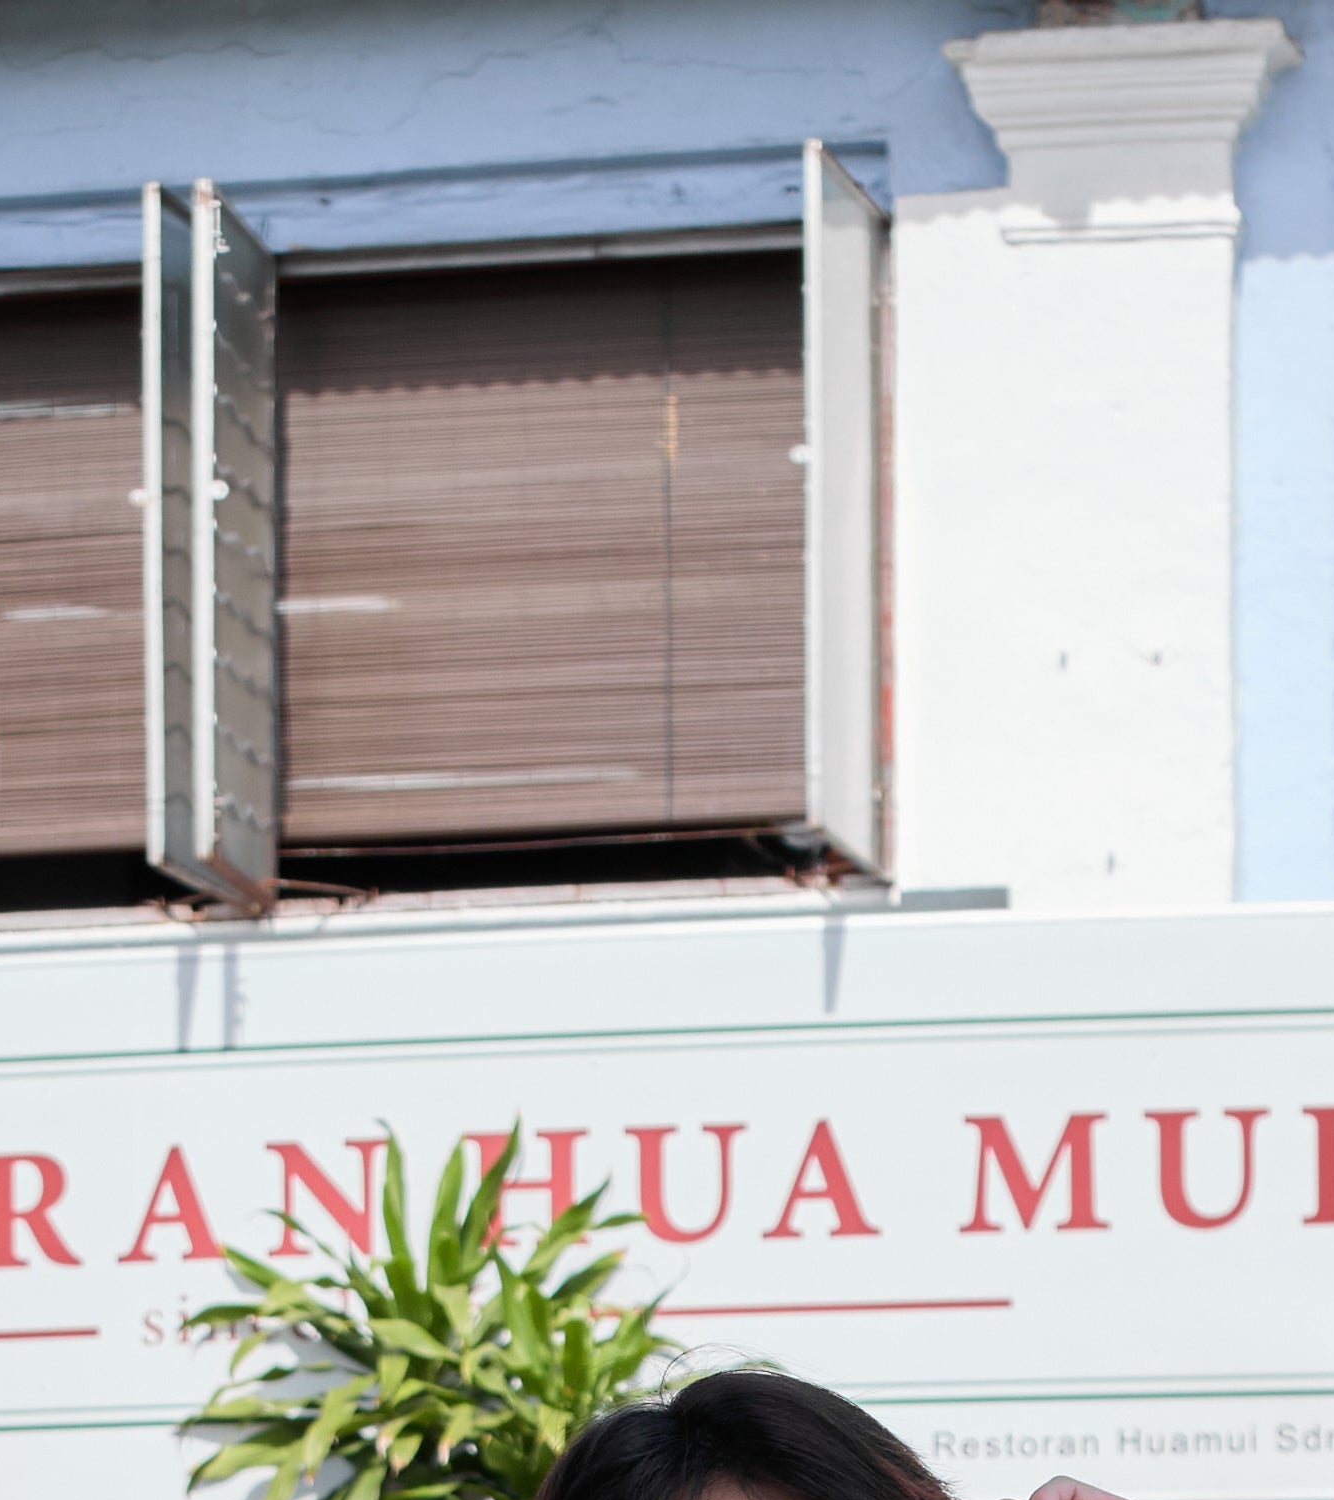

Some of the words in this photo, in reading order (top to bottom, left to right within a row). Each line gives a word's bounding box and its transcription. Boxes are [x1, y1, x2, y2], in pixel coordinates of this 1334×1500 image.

[465, 1118, 881, 1248] HUA
[932, 1430, 1100, 1458] Restoran
[1116, 1428, 1257, 1454] Huamui
